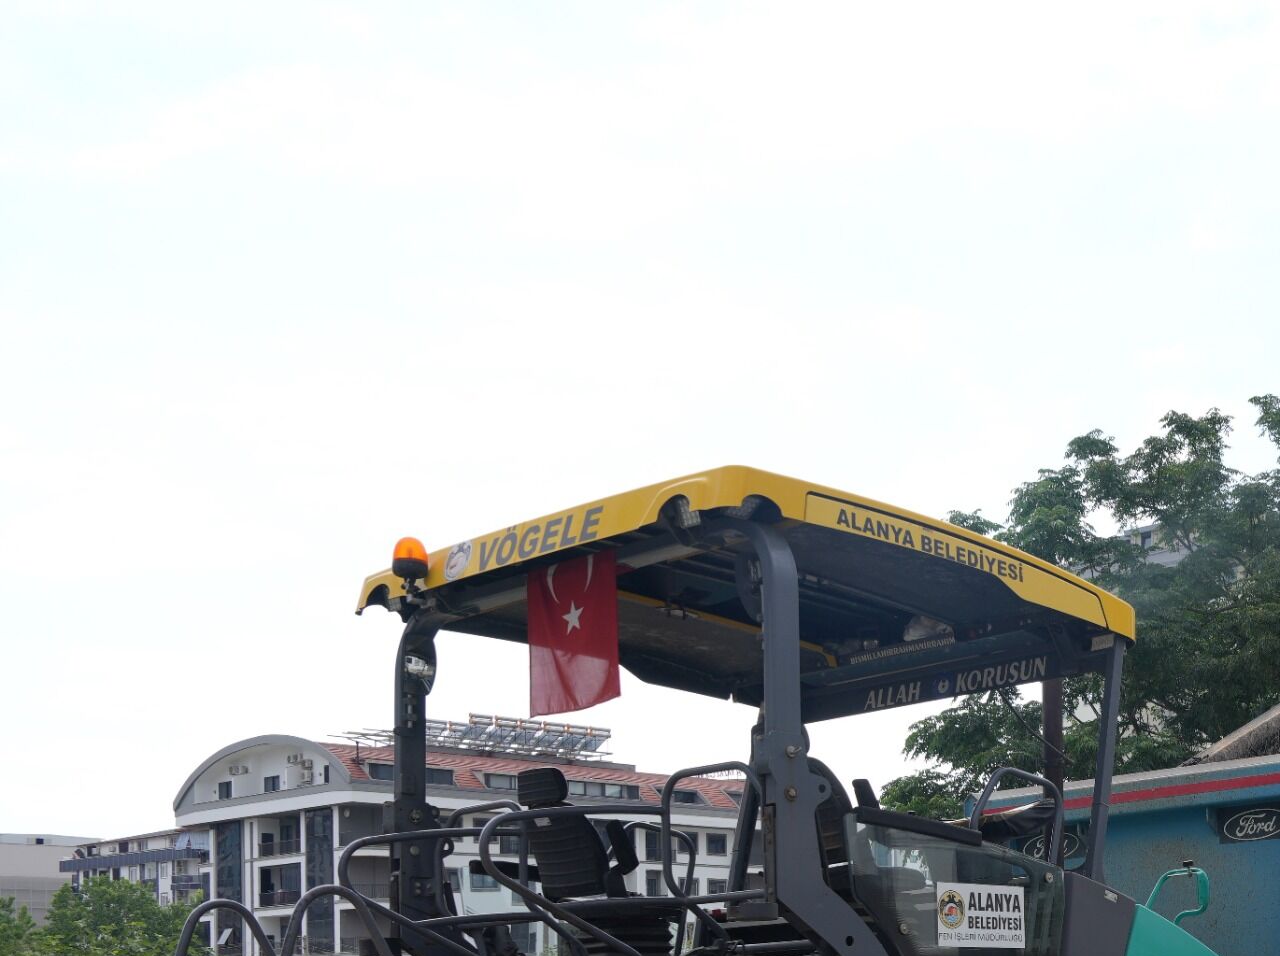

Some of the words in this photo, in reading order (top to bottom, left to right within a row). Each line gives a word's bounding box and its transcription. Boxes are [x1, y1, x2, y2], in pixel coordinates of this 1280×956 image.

[478, 506, 604, 572] VÖGELE
[836, 508, 915, 548] ALANYA
[920, 534, 1024, 583] BELEDİYESİ
[864, 681, 921, 711] ALLAH
[956, 656, 1047, 693] KORUSUN
[1236, 813, 1277, 837] Ford
[968, 892, 1021, 913] ALANYA
[968, 914, 1022, 931] BELEDİYESİ
